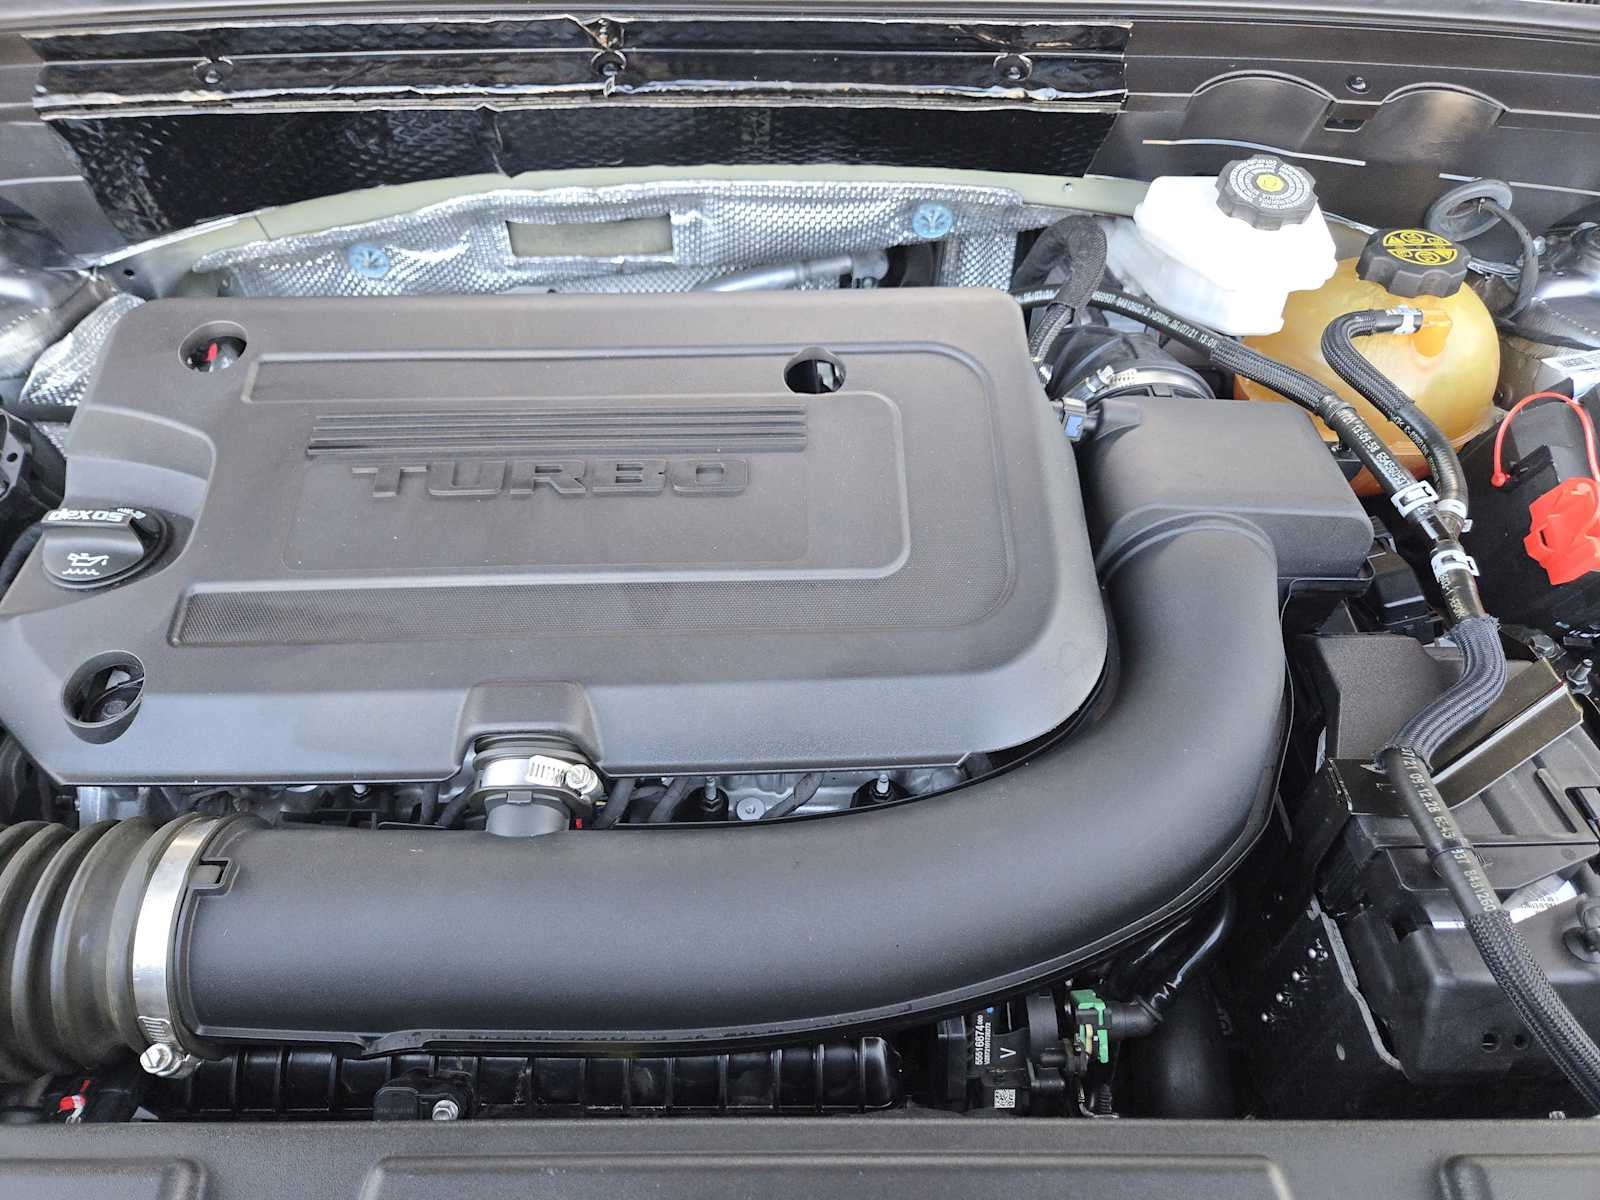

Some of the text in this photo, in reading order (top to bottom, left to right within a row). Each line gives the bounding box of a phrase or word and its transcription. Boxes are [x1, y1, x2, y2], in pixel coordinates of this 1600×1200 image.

[1351, 424, 1380, 453] 13:09:58
[352, 459, 750, 497] TURBO
[48, 507, 124, 522] dexos
[1409, 773, 1441, 813] 09:12:28
